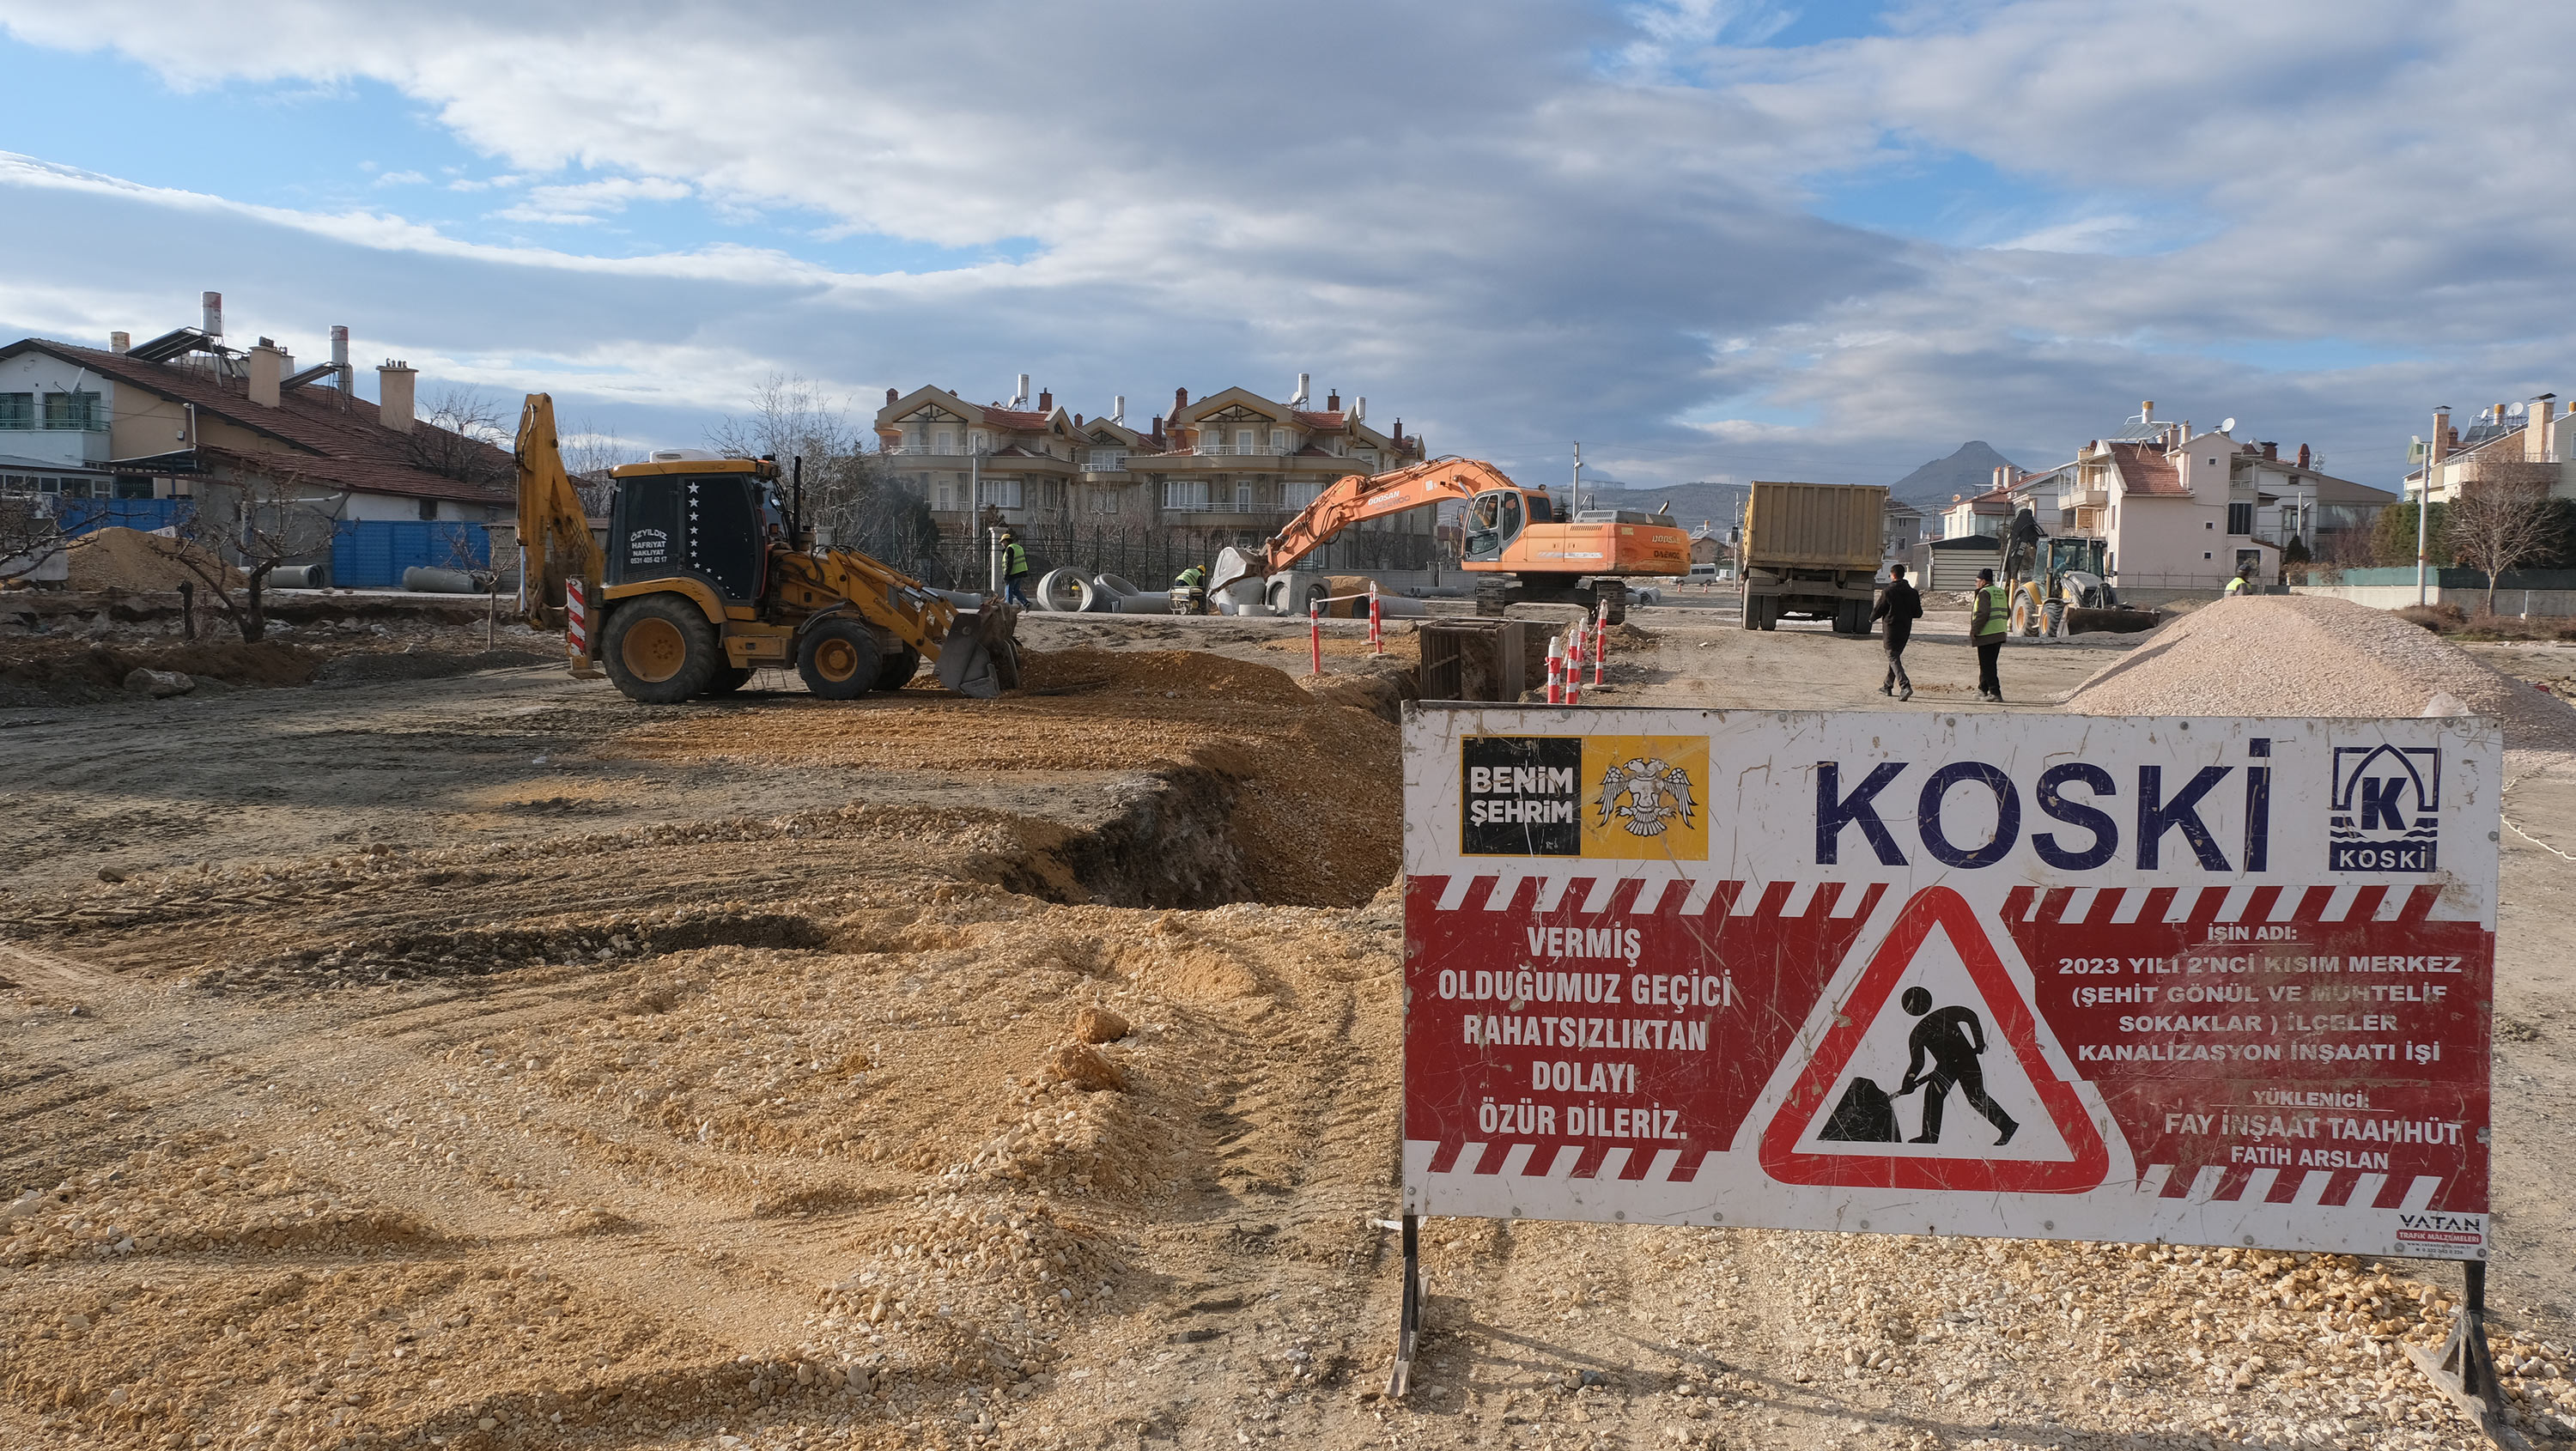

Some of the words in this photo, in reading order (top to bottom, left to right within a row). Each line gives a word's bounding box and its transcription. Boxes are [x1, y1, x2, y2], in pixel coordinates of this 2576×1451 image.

[1368, 490, 1400, 506] DOOSAN
[630, 529, 667, 542] ÖZYILDIZ
[631, 541, 666, 549] HAFRİYAT
[1652, 535, 1680, 543] DOOSAN
[1654, 550, 1680, 559] DAEWOO
[1470, 766, 1573, 794] BENİM
[1469, 799, 1573, 828] ŞEHRİM
[1815, 738, 2270, 871] KOSKİ
[2339, 846, 2427, 869] KOSKİ
[1528, 921, 1642, 968] VERMİŞ
[2208, 923, 2250, 945] İŞİN
[2255, 926, 2298, 940] ADI:
[2058, 957, 2120, 974] 2023
[2128, 957, 2178, 974] YILI
[2187, 953, 2256, 974] 2'NCİ
[2264, 956, 2340, 973] KISIM
[2348, 956, 2463, 973] MERKEZ
[1438, 963, 1621, 1005] OLDUĞUMUZ
[1631, 968, 1732, 1013] GEÇİCİ
[2072, 982, 2159, 1008] (ŞEHİT
[2167, 982, 2259, 1003] GÖNÜL
[2268, 986, 2302, 1002] VE
[2310, 981, 2448, 1003] MUHTELİF
[1463, 1014, 1707, 1052] RAHATSIZLIKTAN
[2119, 1016, 2263, 1032] SOKAKLAR
[2078, 1040, 2281, 1061] KANALİZASYON
[2290, 1041, 2396, 1064] İNŞAATI
[2405, 1041, 2440, 1065] İŞİ
[1532, 1060, 1636, 1095] DOLAYI
[2252, 1087, 2370, 1108] YÜKLENİCİ:
[1479, 1097, 1556, 1136] ÖZÜR
[1567, 1101, 1688, 1140] DİLERİZ.
[2165, 1113, 2215, 1135] FAY
[2222, 1109, 2321, 1143] İNŞAAT
[2327, 1116, 2462, 1145] TAAHHÜT
[2231, 1144, 2292, 1166] FATİH
[2299, 1149, 2390, 1170] ARSLAN
[2399, 1214, 2480, 1232] VATAN
[2427, 1233, 2480, 1242] MALZEMELERİ
